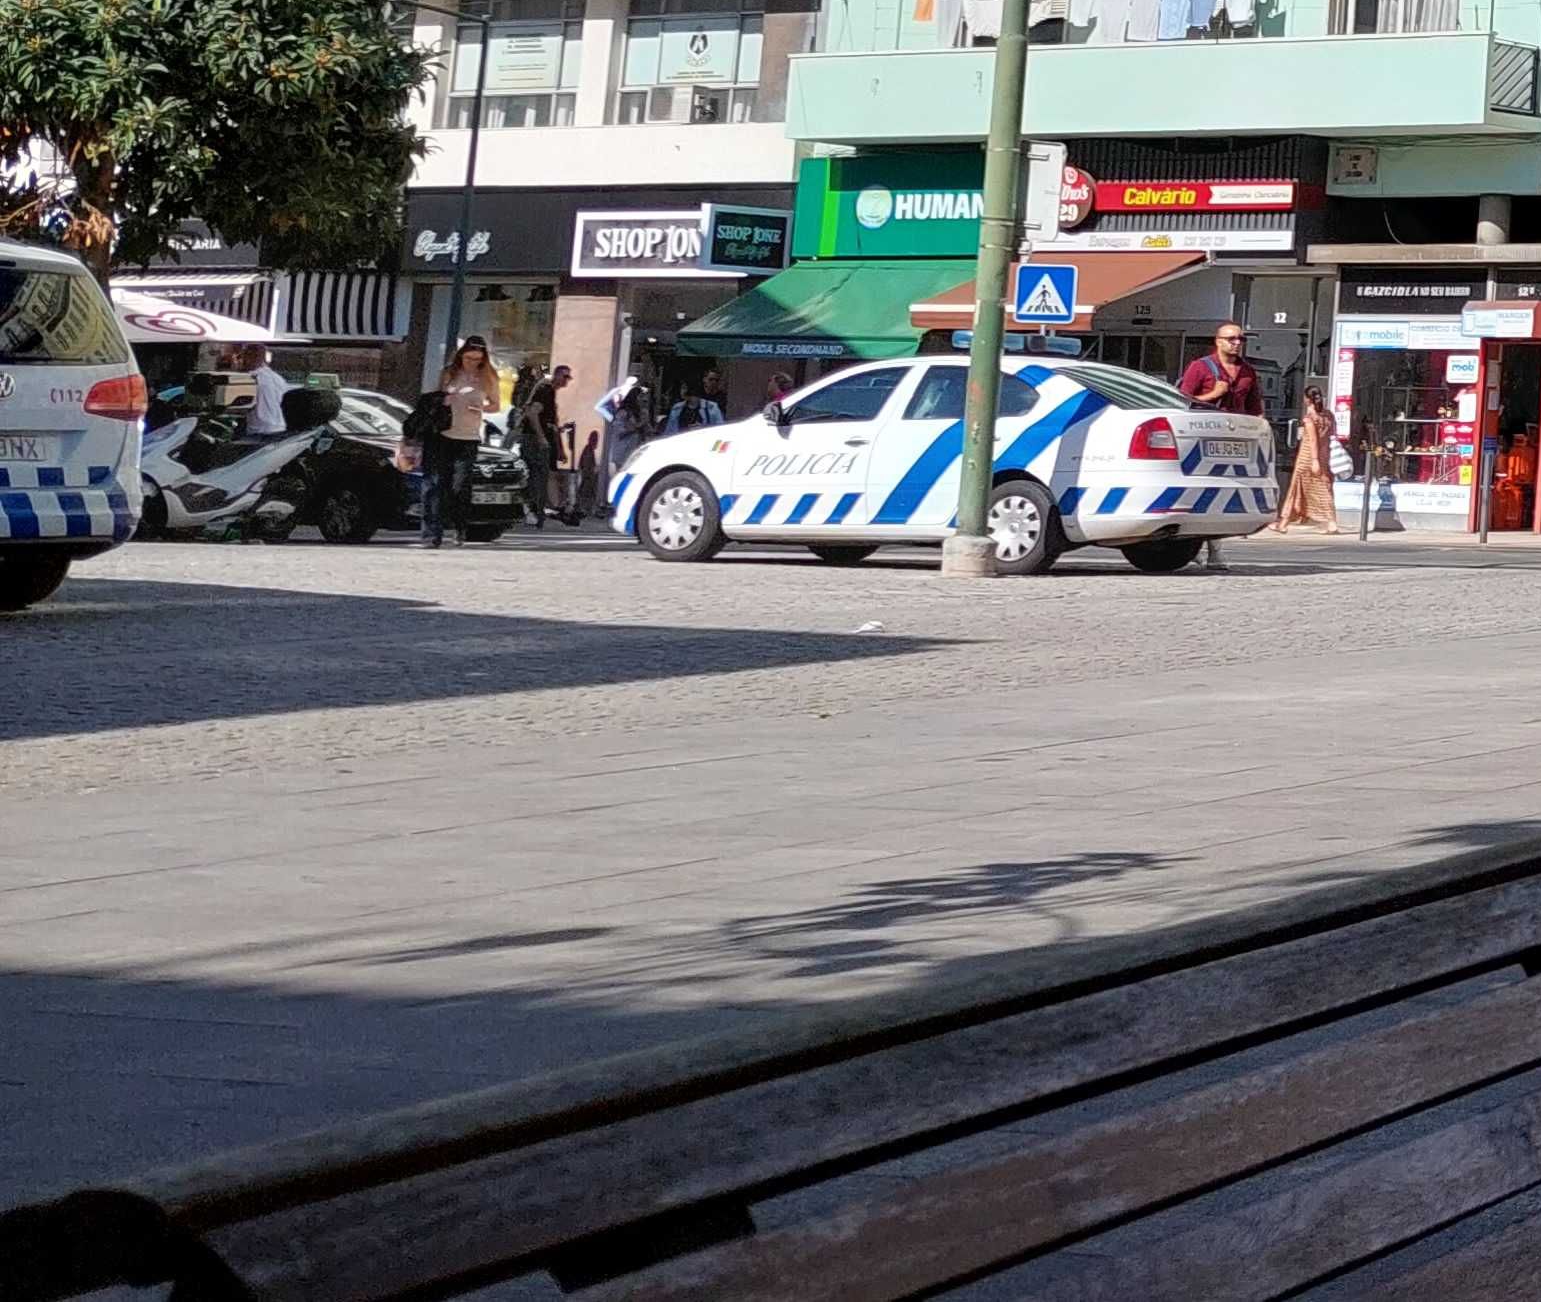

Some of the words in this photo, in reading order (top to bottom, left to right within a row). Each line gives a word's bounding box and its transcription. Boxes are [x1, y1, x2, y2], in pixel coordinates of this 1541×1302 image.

[1123, 187, 1197, 206] Calvário
[594, 225, 659, 259] SHOP
[717, 225, 752, 241] SHOP
